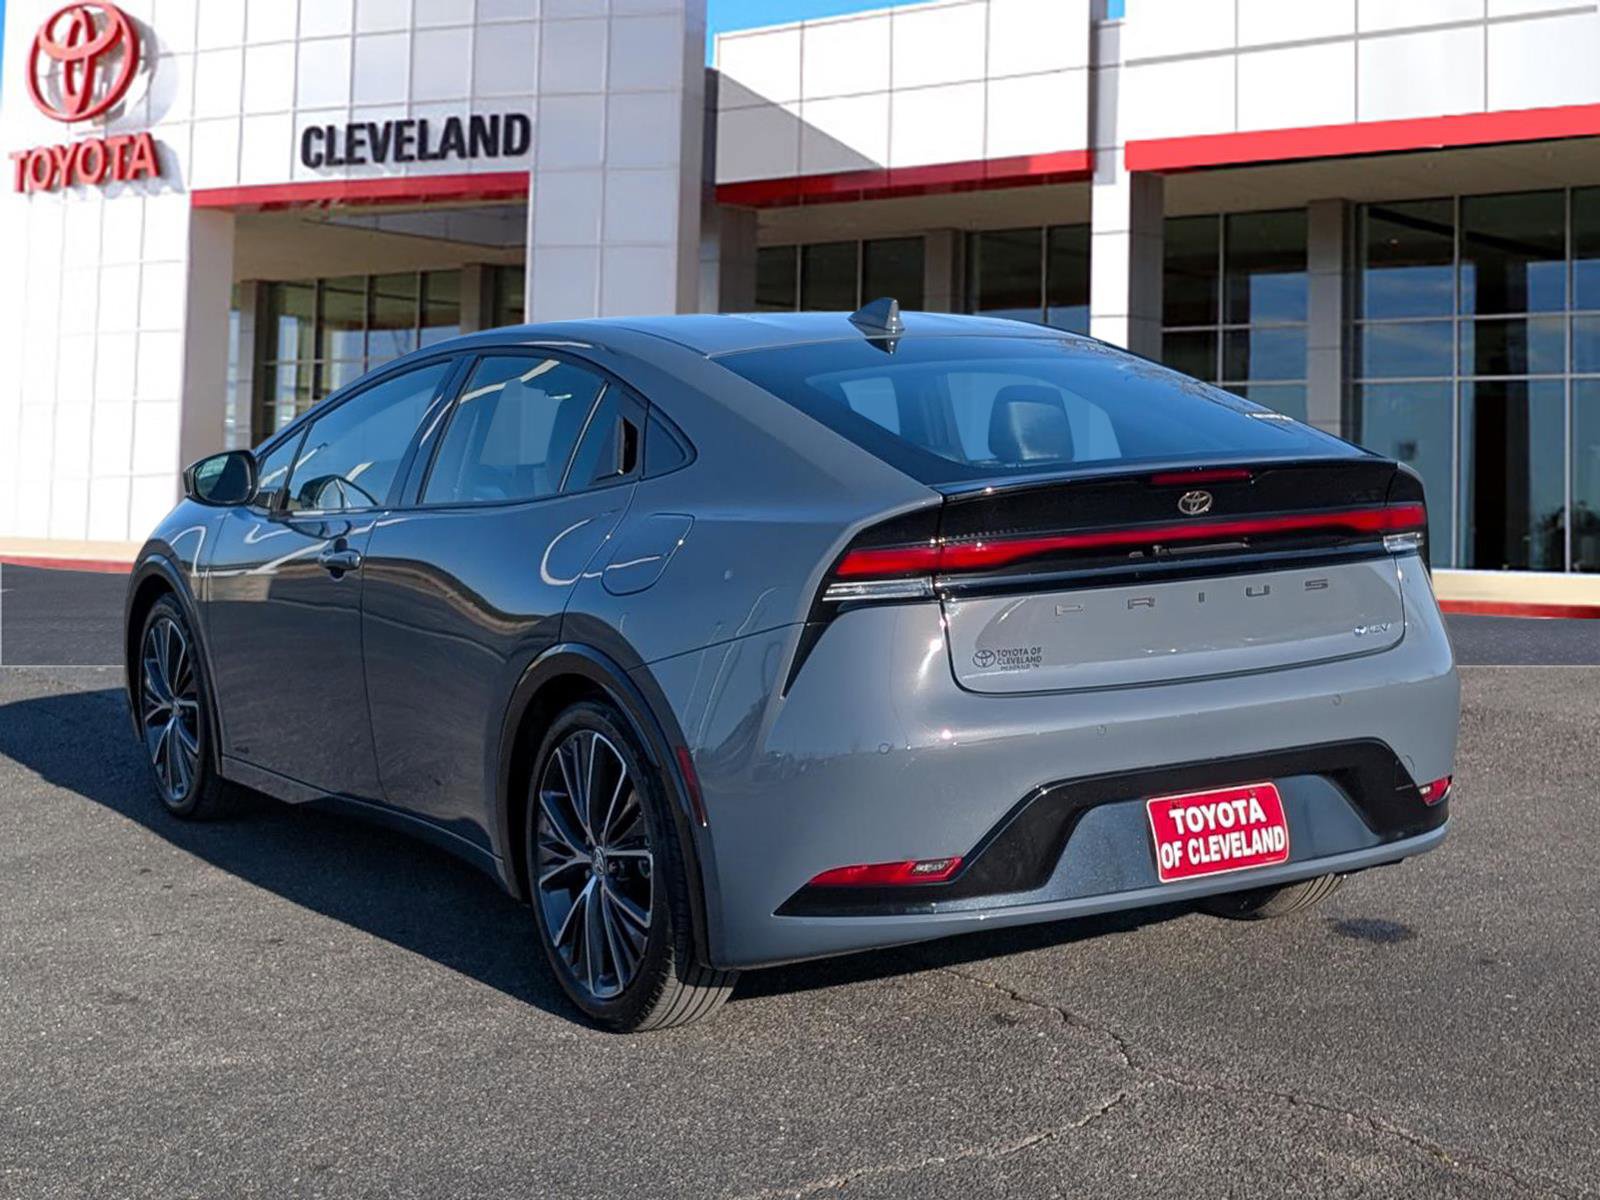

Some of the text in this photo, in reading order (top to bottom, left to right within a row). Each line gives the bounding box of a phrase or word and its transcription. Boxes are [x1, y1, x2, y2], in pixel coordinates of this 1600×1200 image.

[300, 113, 532, 170] CLEVELAND
[8, 131, 162, 194] TOYOTA
[1054, 578, 1329, 617] PRIUS
[996, 646, 1042, 657] TOYOTA OF
[996, 656, 1043, 666] CLEVELAND
[1168, 797, 1267, 836] TOYOTA
[1160, 825, 1286, 870] OF CLEVELAND
